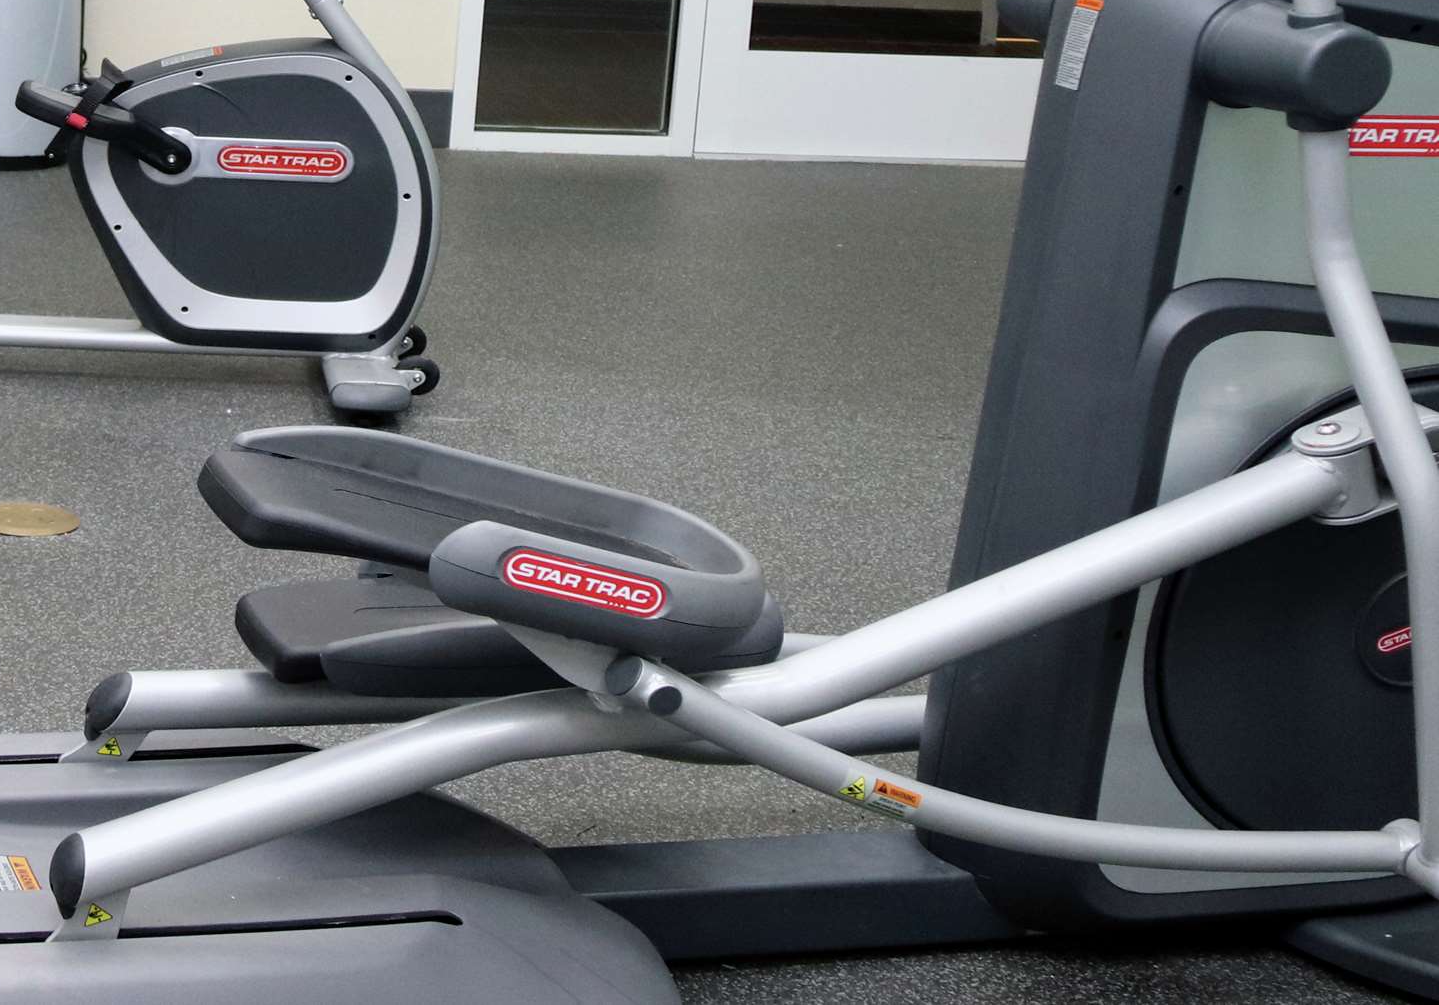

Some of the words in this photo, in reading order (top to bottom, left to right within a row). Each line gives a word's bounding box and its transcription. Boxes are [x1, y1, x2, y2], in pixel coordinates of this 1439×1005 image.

[1347, 128, 1400, 143] TAR
[227, 154, 278, 165] STAR
[281, 156, 335, 167] TRAC
[516, 563, 581, 588] STAR
[585, 578, 651, 604] TRAC
[1384, 633, 1409, 647] STA
